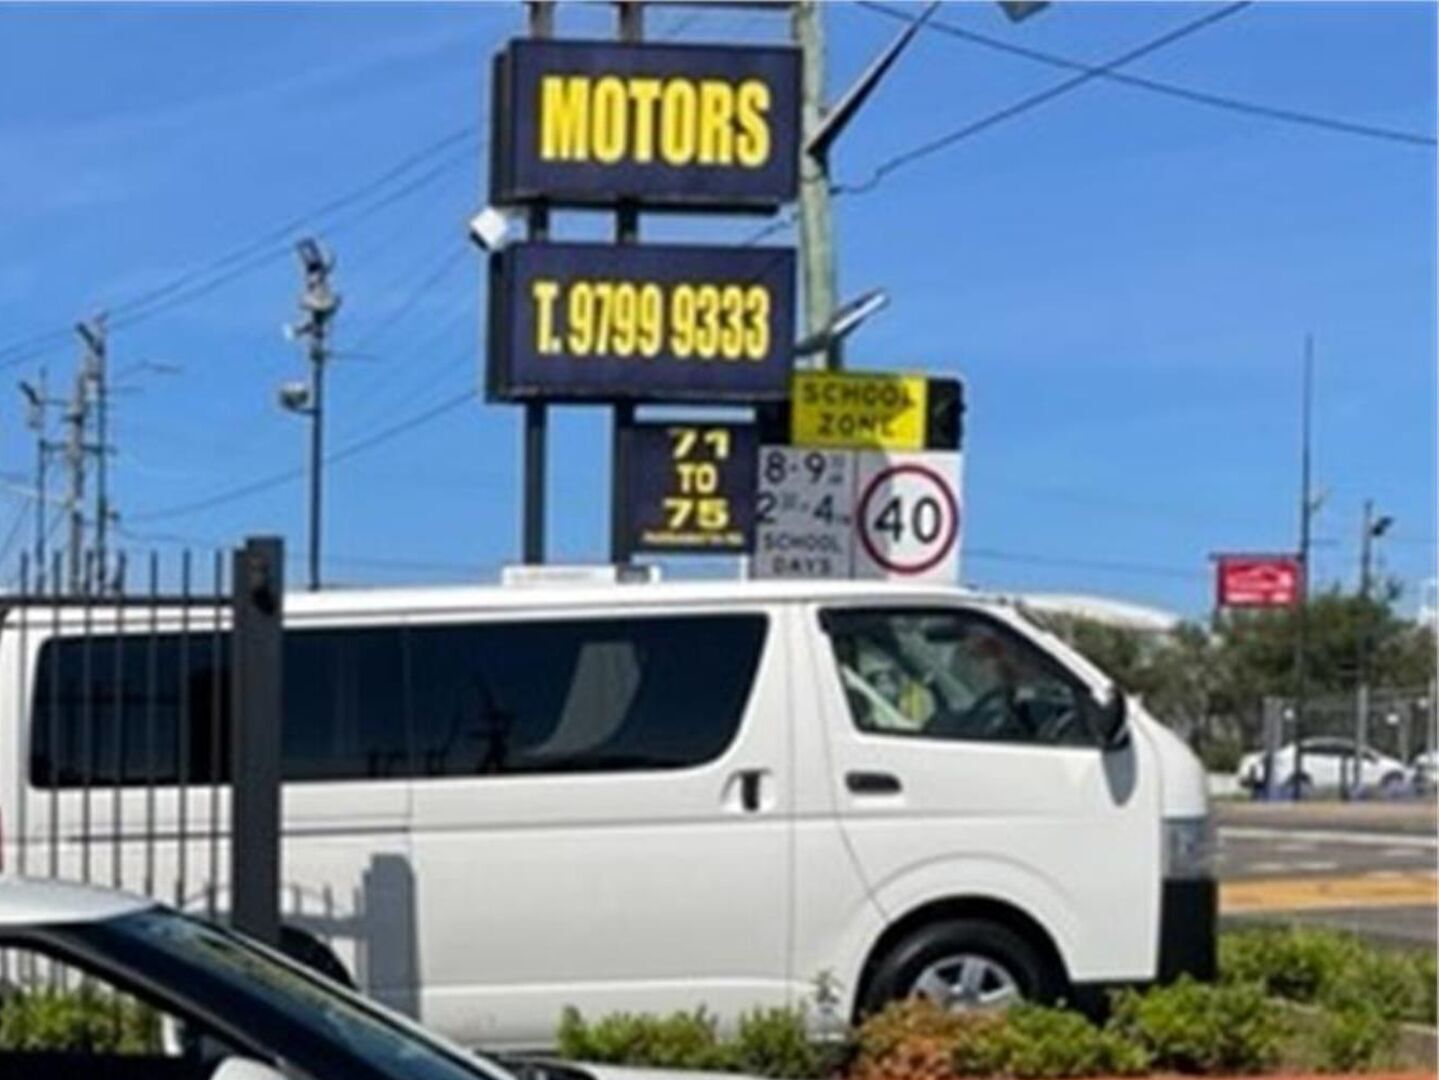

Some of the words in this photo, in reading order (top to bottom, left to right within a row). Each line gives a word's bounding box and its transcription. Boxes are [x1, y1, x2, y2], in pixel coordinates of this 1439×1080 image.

[540, 75, 770, 168] MOTORS
[568, 282, 663, 357] 9799
[671, 284, 770, 360] 9333
[802, 381, 916, 407] SCHOOL
[818, 413, 898, 438] ZONE
[667, 428, 730, 459] 71
[677, 462, 719, 494] TO
[663, 497, 729, 530] 75
[873, 496, 943, 545] 40
[763, 533, 842, 554] SCHOOL
[772, 556, 832, 574] DAYS
